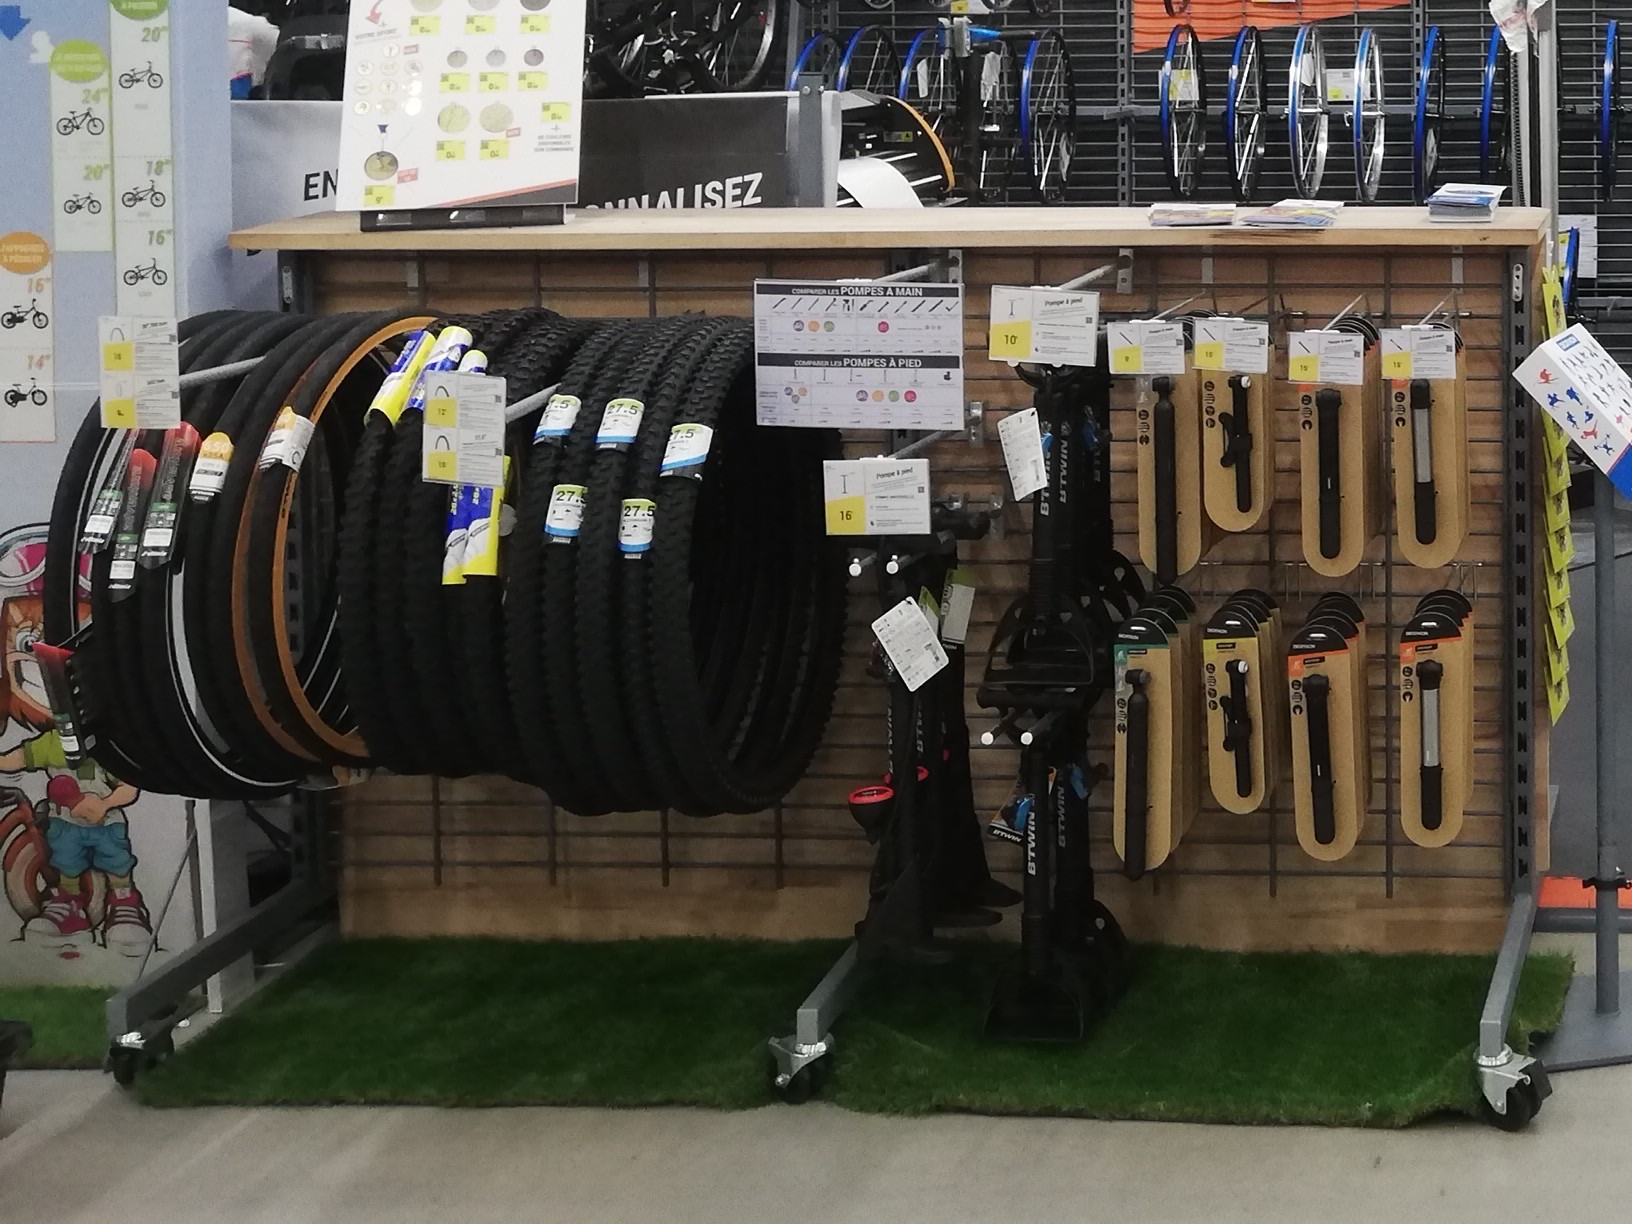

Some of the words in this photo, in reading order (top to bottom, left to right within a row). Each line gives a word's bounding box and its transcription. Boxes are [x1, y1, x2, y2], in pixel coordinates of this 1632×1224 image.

[840, 286, 885, 297] POMPES
[895, 287, 924, 297] MAIN
[843, 358, 888, 368] POMPES
[898, 358, 923, 368] PIED
[607, 403, 639, 416] 27.5
[624, 505, 656, 518] 27.5
